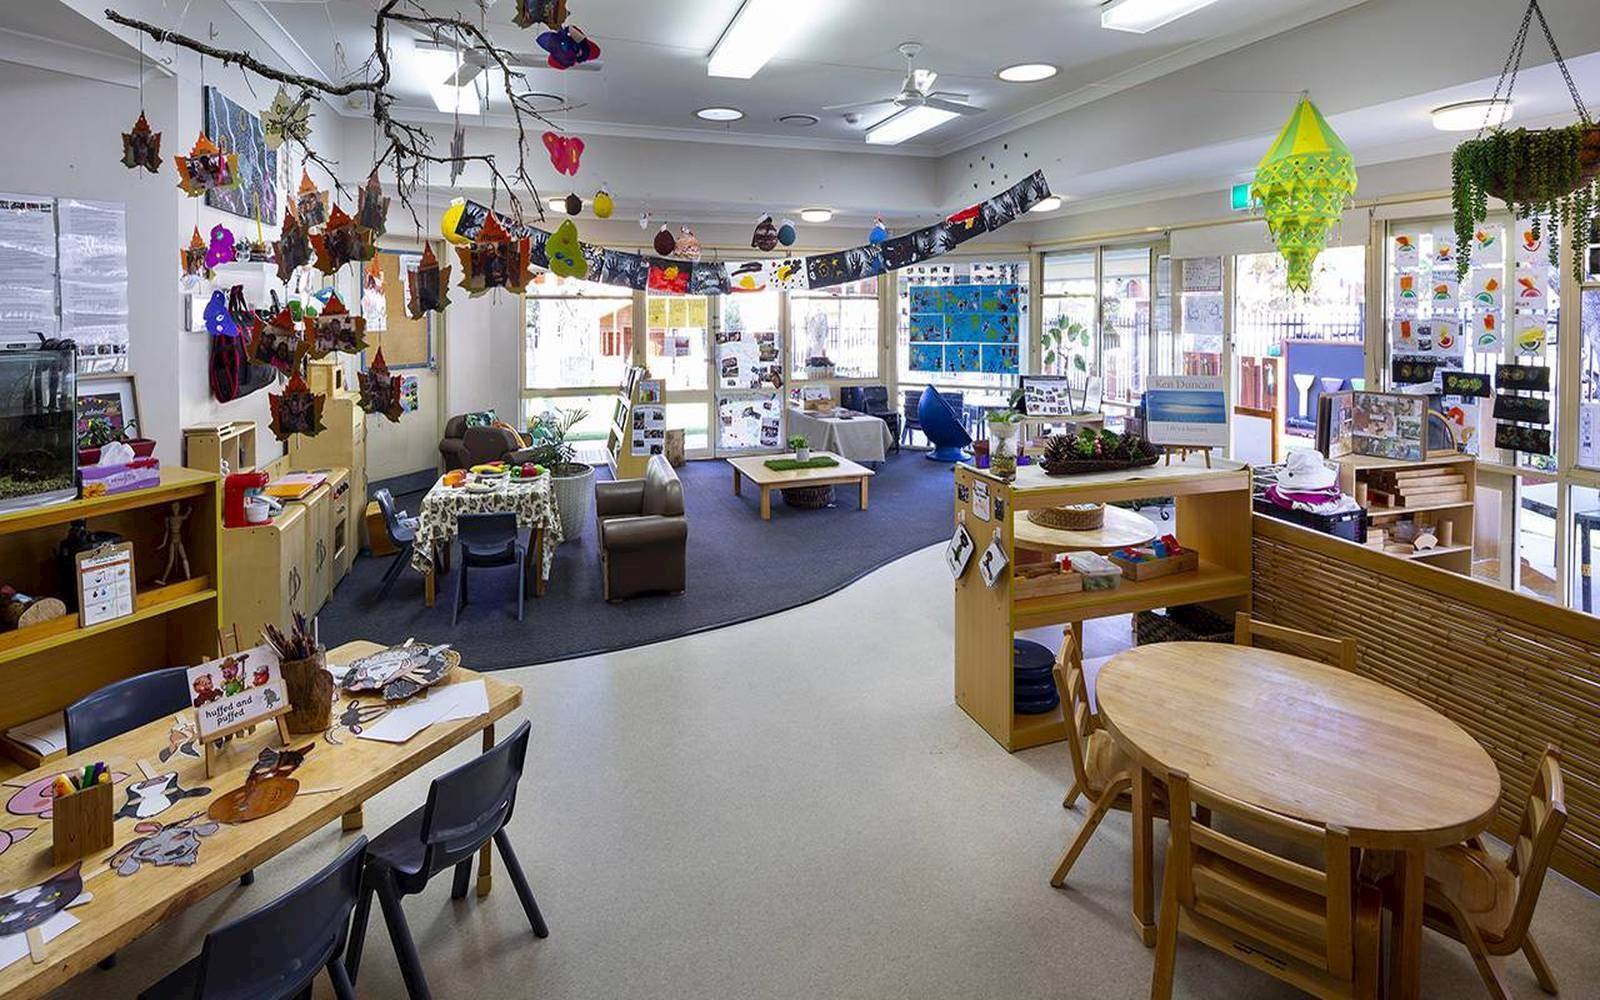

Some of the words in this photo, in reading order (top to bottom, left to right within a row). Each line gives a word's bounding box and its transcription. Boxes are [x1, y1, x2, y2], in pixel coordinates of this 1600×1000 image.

[1156, 379, 1173, 388] Ken
[1176, 379, 1215, 389] Duncan
[205, 702, 234, 719] huffed
[236, 695, 253, 707] and
[217, 708, 245, 726] puffed
